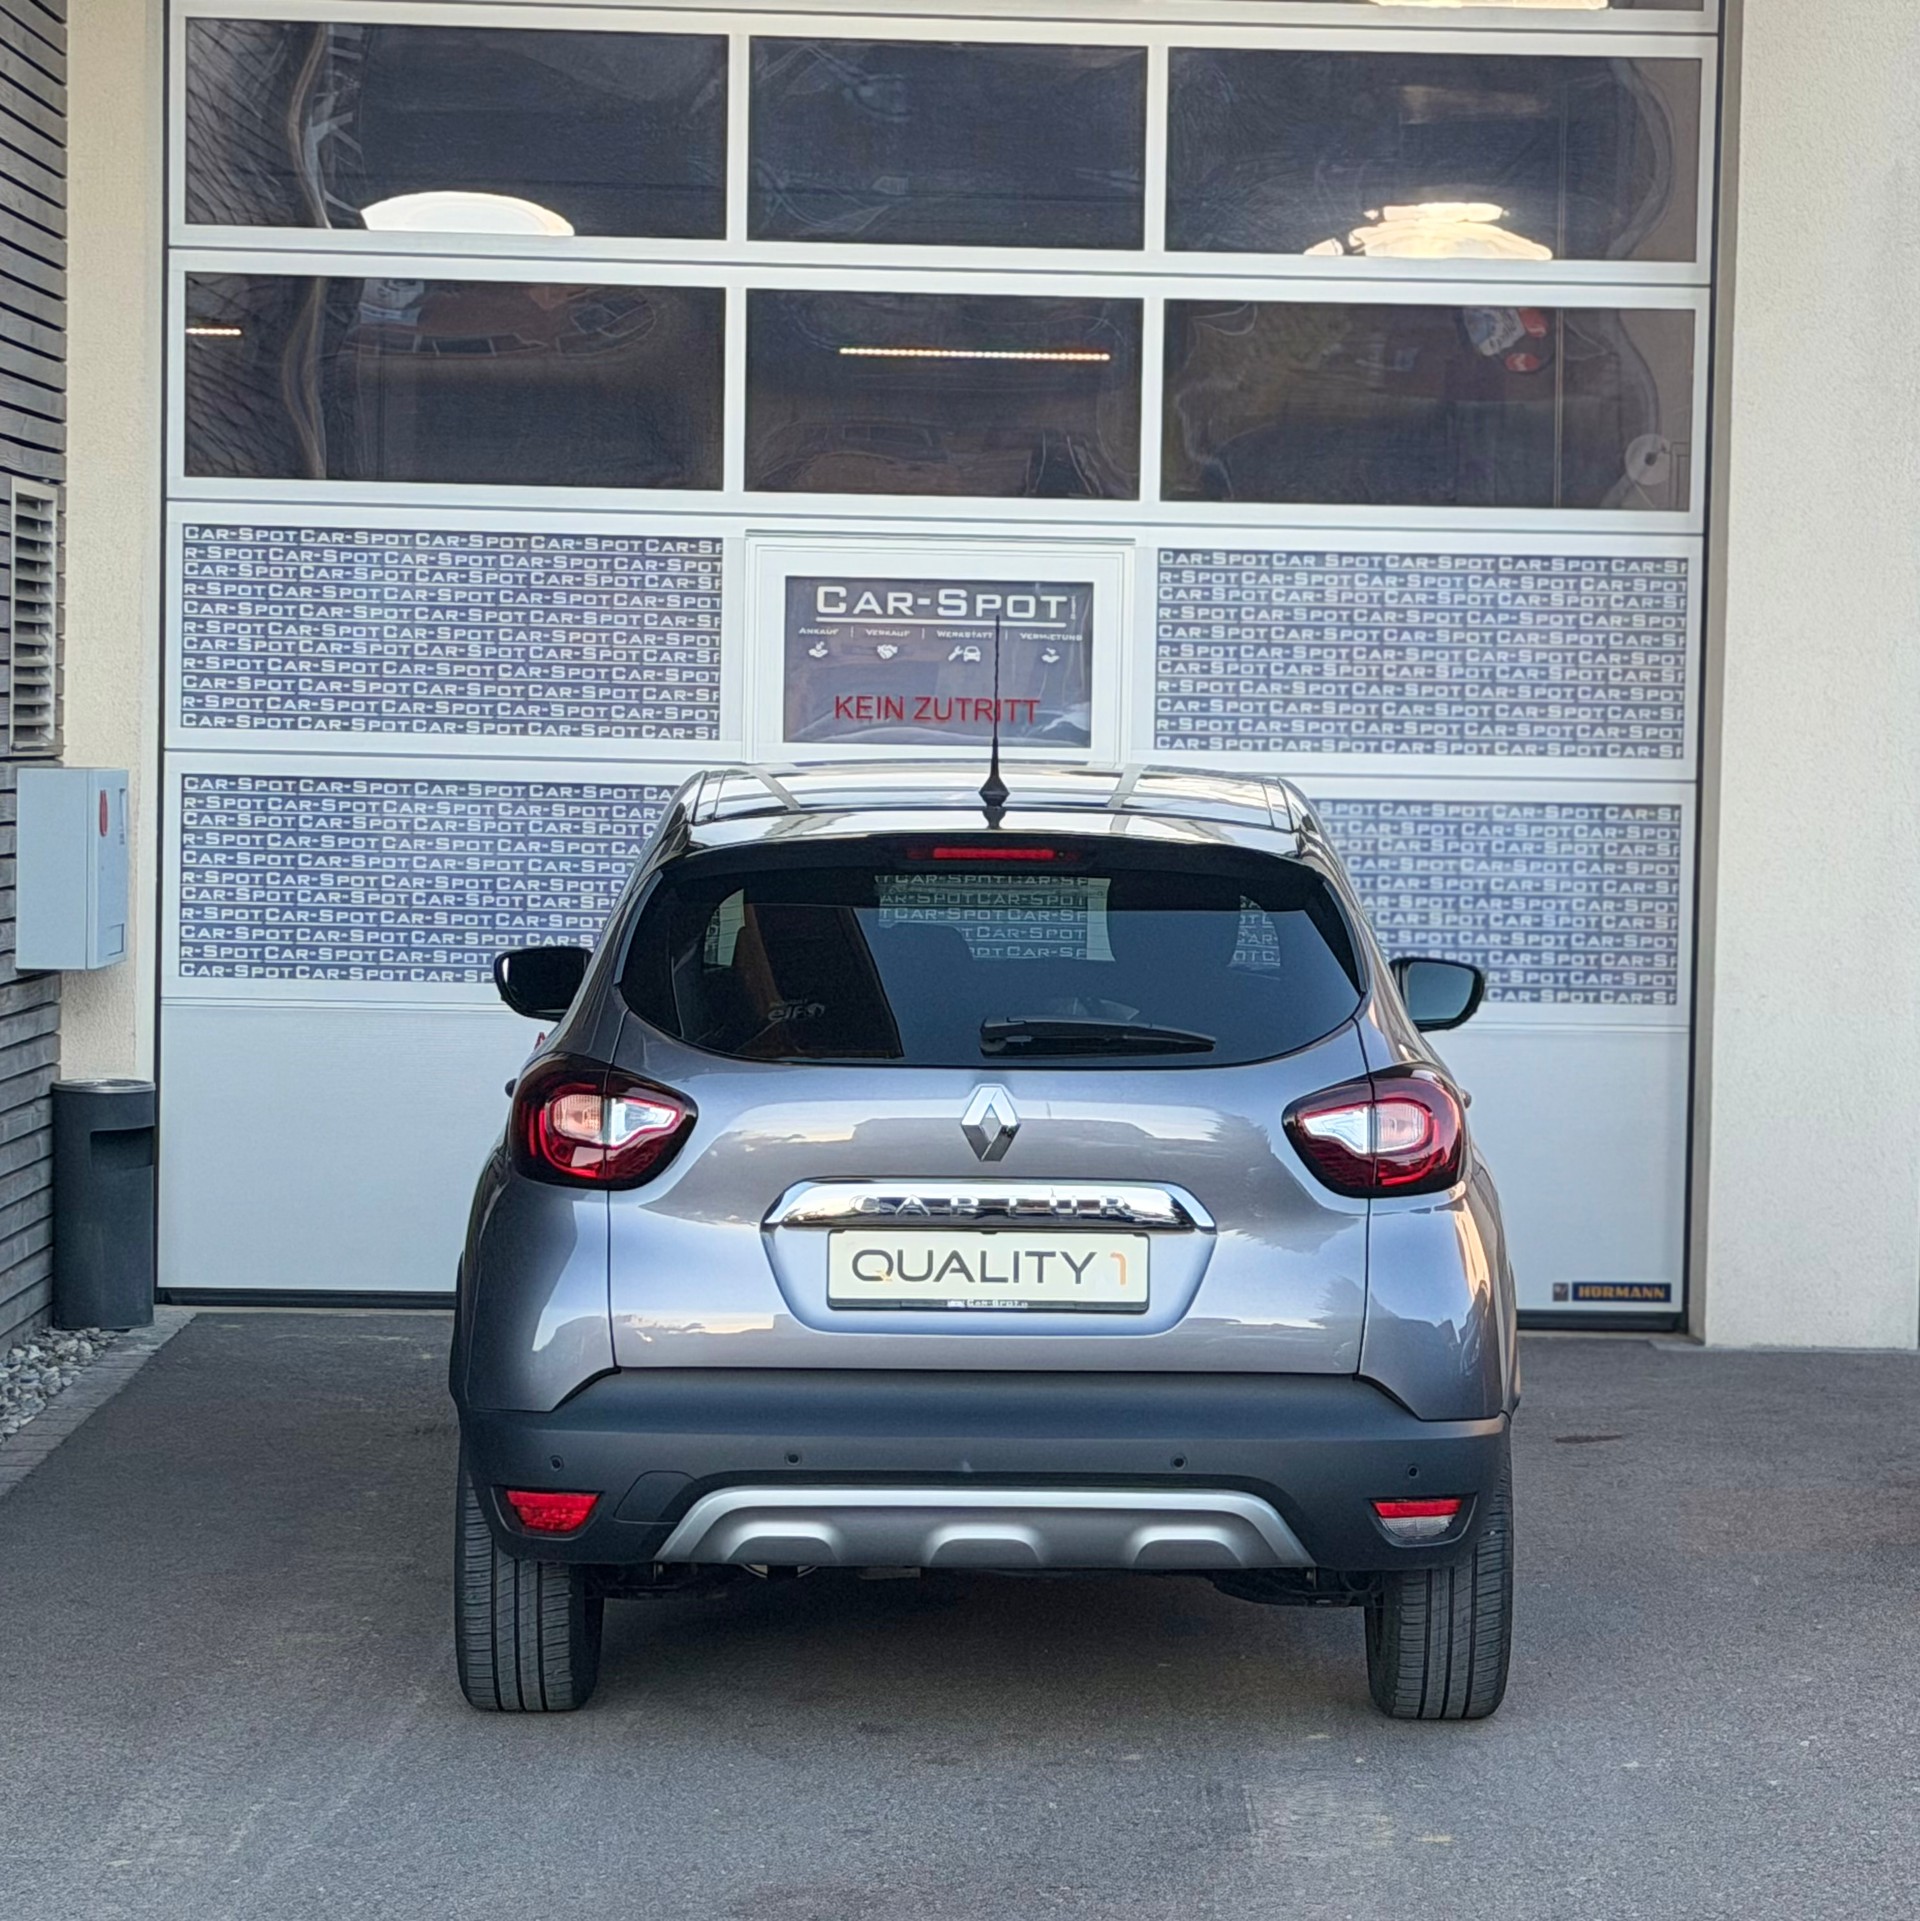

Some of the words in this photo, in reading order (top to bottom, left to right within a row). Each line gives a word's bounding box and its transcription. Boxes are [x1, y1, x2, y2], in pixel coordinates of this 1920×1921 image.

[816, 586, 1067, 619] CAR-SPOT
[834, 696, 904, 720] KEIN
[914, 697, 1040, 724] ZUTRITT
[849, 1194, 1131, 1219] CAPTUR
[852, 1250, 1098, 1284] QUALITY
[1110, 1252, 1127, 1286] 1
